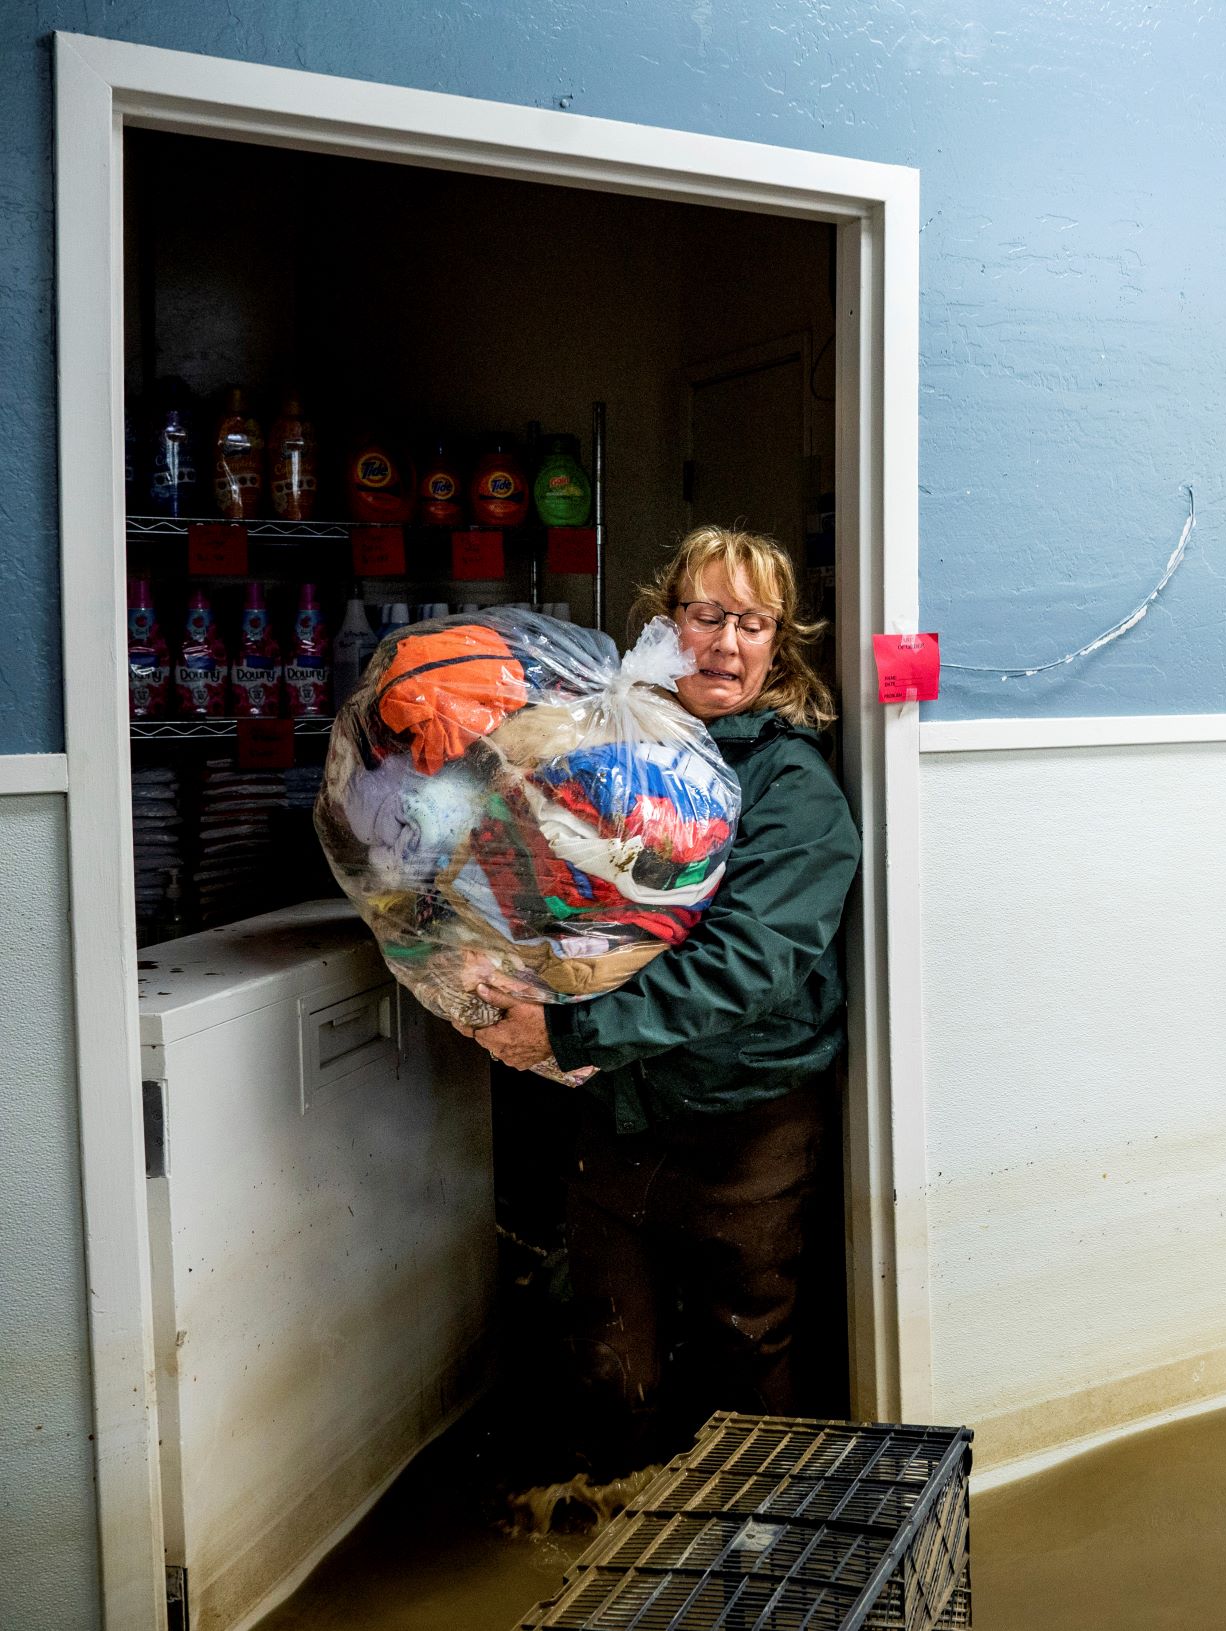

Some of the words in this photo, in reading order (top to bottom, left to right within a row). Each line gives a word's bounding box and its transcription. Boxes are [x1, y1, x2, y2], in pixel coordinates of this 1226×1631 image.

[360, 459, 390, 481] Tide
[431, 480, 453, 494] Tide
[490, 478, 514, 493] Tide
[179, 668, 221, 683] Downy
[236, 668, 275, 683] Downy
[286, 667, 326, 683] Downy
